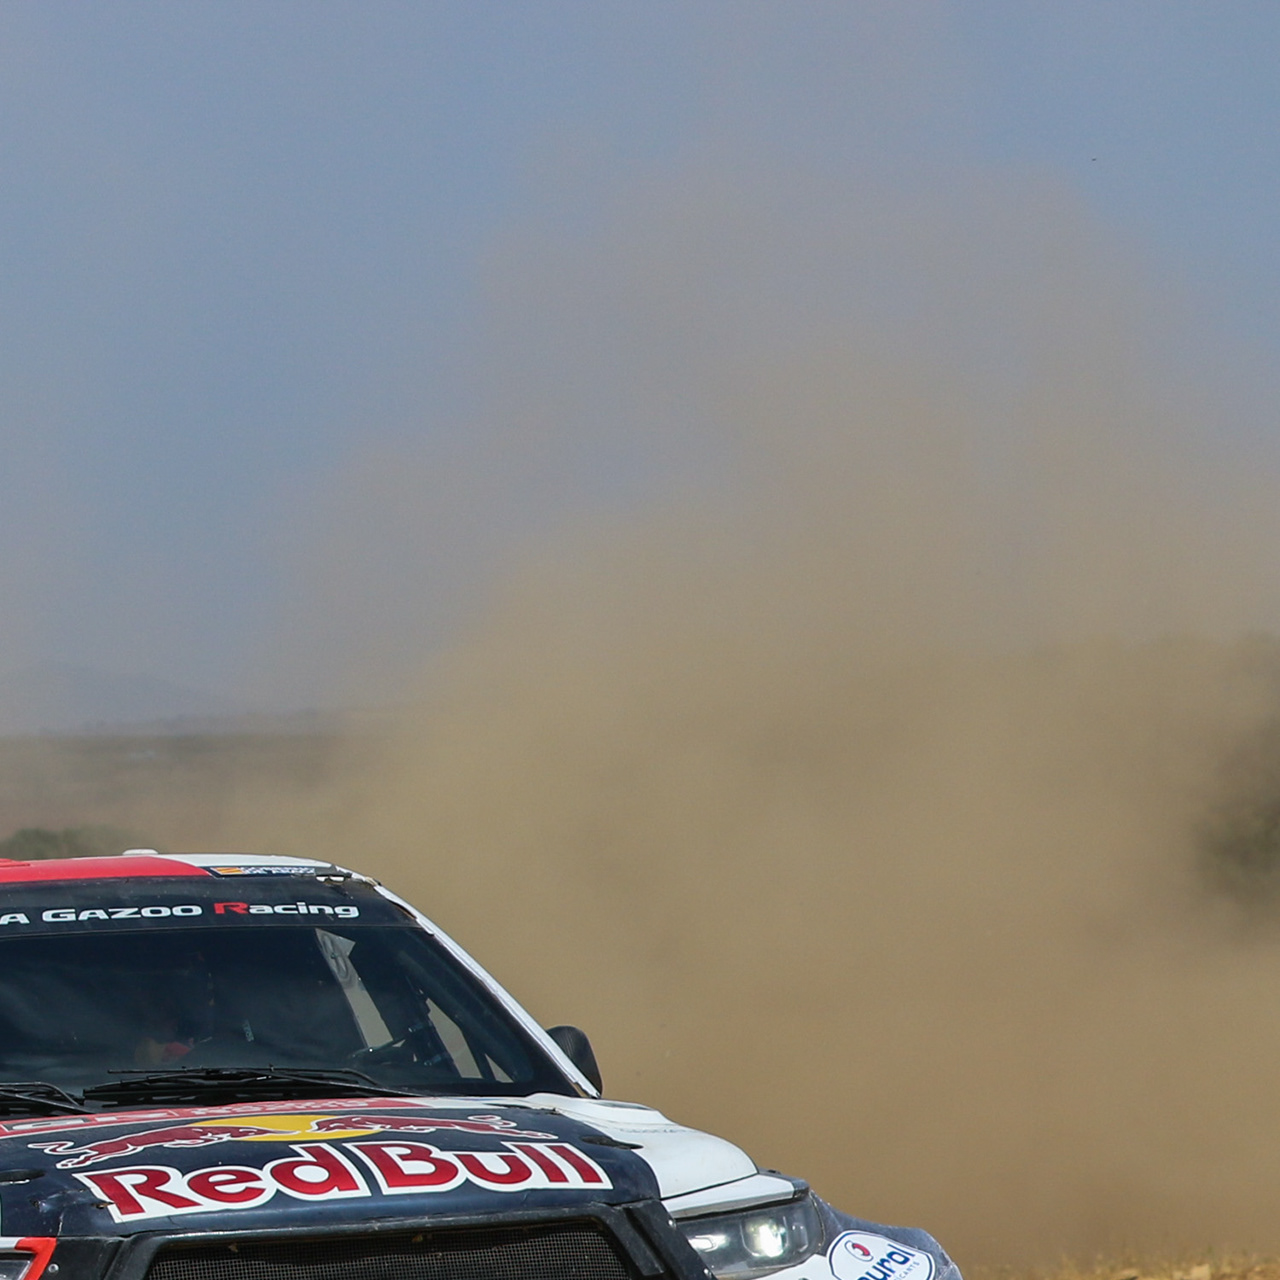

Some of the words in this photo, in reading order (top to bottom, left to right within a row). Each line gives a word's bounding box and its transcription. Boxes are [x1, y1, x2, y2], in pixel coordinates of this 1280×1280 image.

[42, 904, 203, 923] GAZOO
[214, 902, 360, 918] Racing
[76, 1143, 369, 1220] Red
[348, 1141, 611, 1194] Bull
